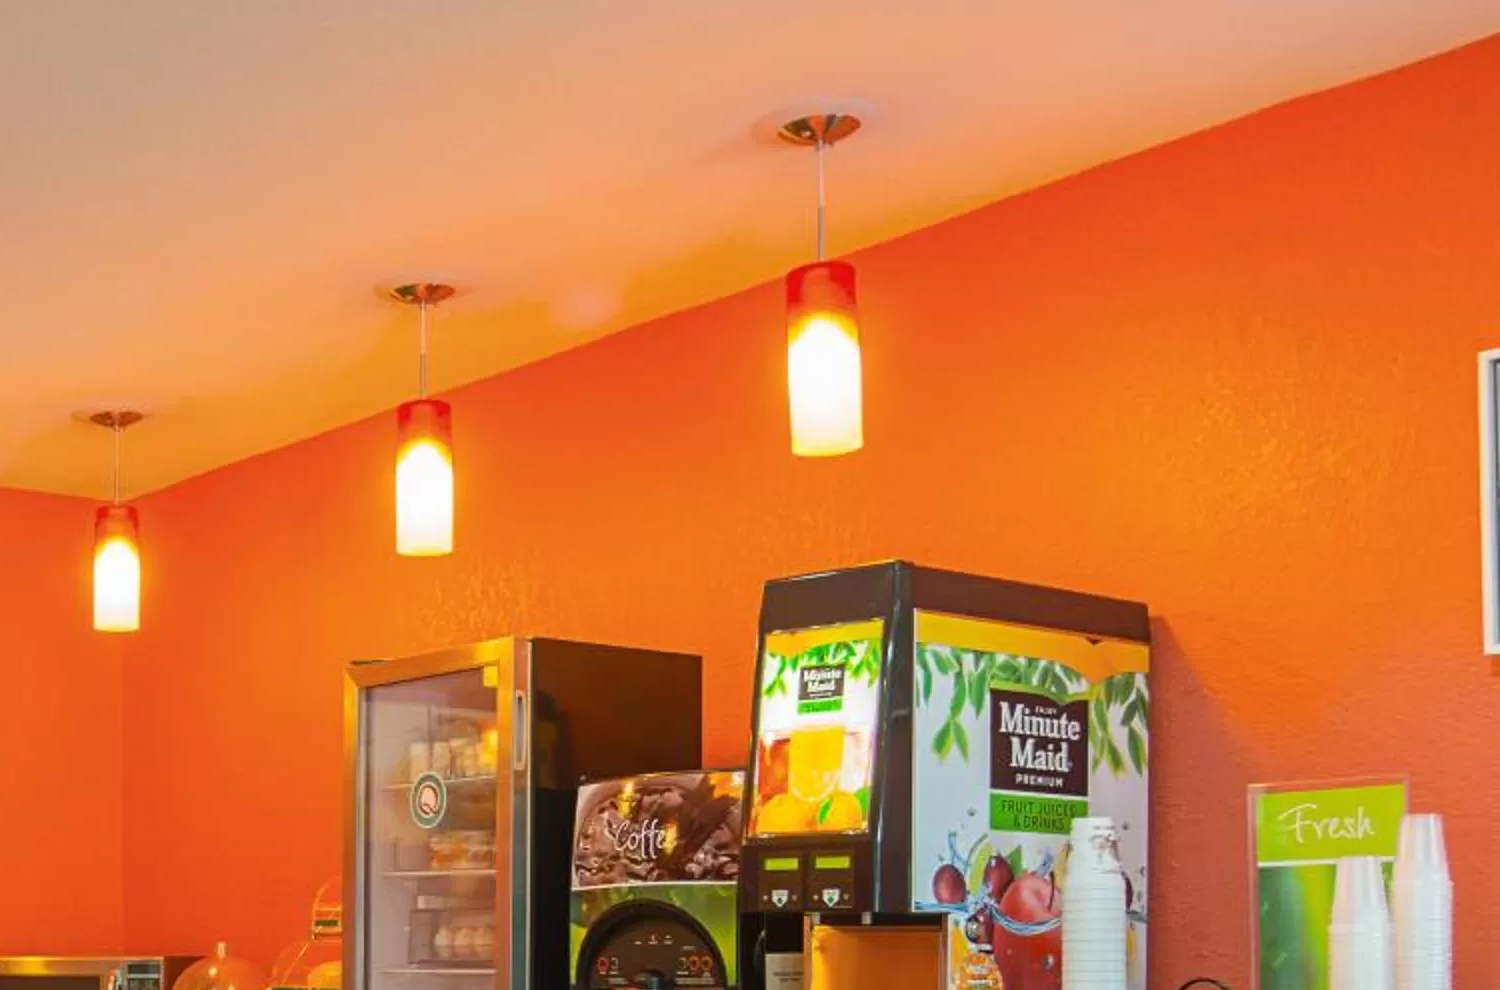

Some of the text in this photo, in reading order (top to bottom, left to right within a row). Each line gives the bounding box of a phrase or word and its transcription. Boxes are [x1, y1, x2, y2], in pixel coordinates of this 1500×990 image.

[998, 701, 1081, 740] Minute
[1009, 736, 1069, 773] Maid
[1015, 773, 1064, 788] PREMIUM
[1001, 799, 1034, 815] FRUIT
[1023, 815, 1065, 831] DRINKS
[1277, 802, 1376, 844] Fresh
